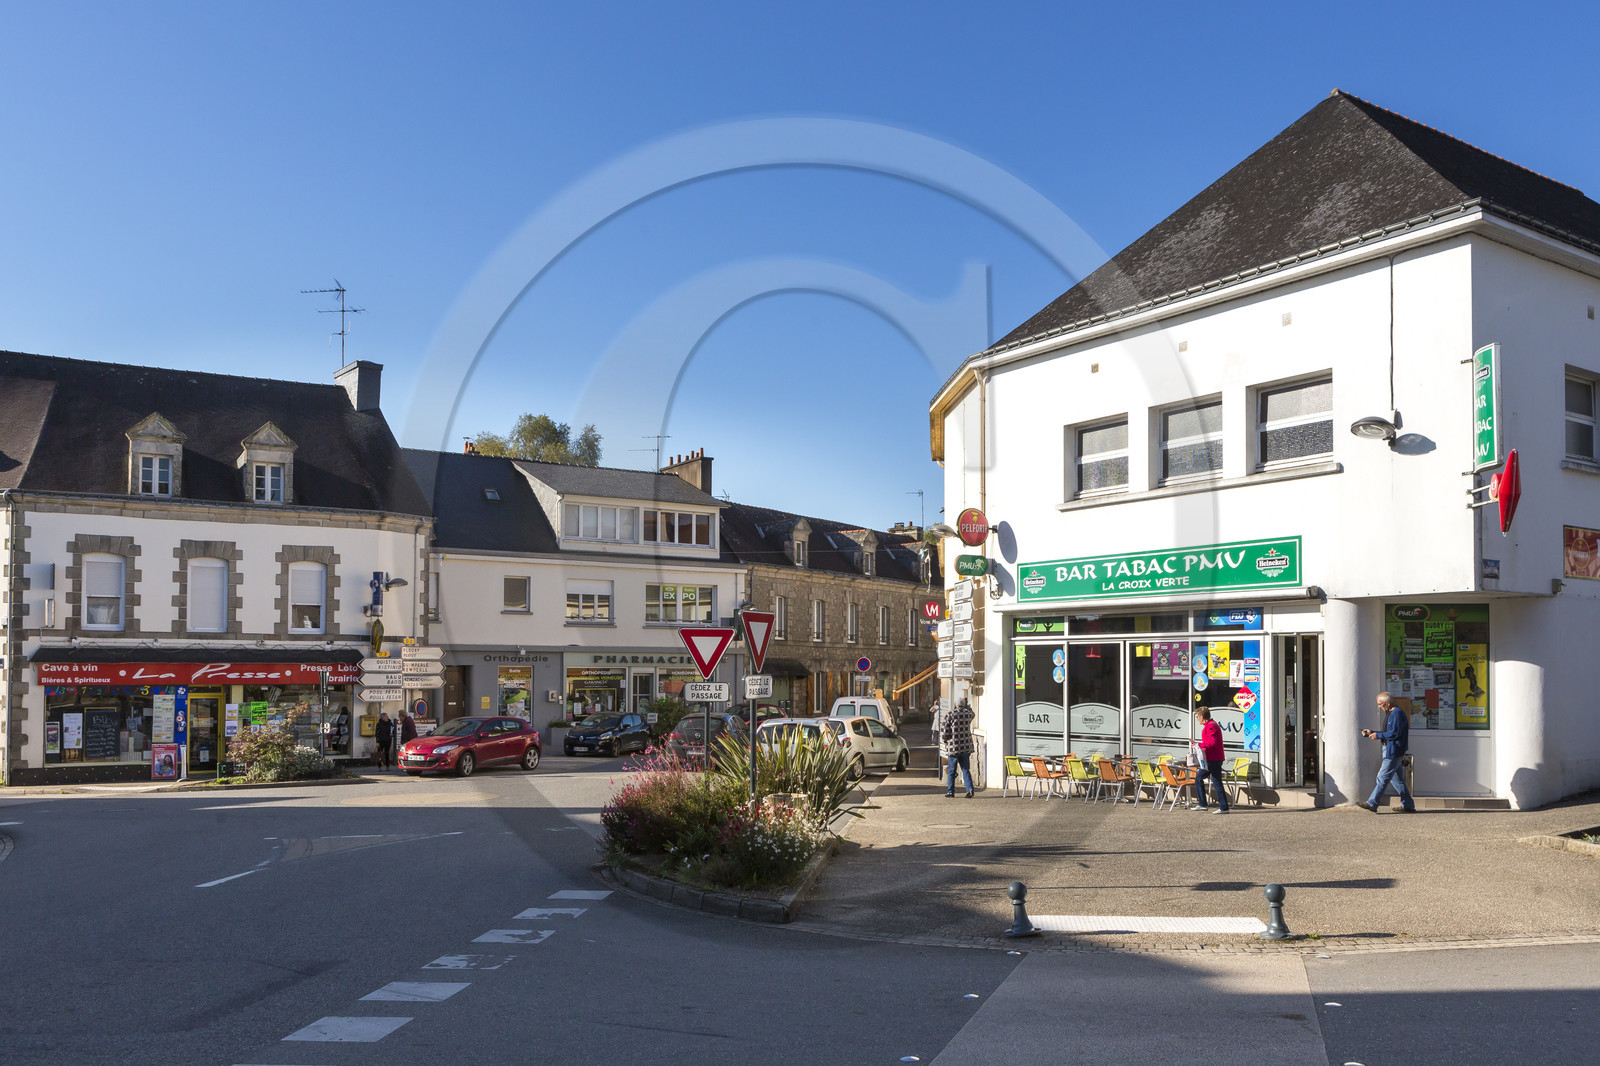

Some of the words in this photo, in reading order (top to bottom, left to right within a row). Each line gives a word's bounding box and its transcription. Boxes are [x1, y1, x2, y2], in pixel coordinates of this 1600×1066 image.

[962, 524, 987, 533] PELFORTH
[1054, 564, 1097, 582] BAR
[1102, 557, 1176, 578] TABAC
[1102, 582, 1114, 590] LA
[1118, 580, 1152, 589] CROIX
[1156, 576, 1190, 587] VERTE
[593, 655, 695, 664] PHARMACIE
[72, 663, 78, 672] à
[82, 663, 98, 672] vin
[132, 668, 176, 679] La
[191, 663, 280, 683] Presse
[1029, 713, 1050, 724] BAR
[1139, 717, 1182, 730] TABAC
[1218, 721, 1243, 733] MU
